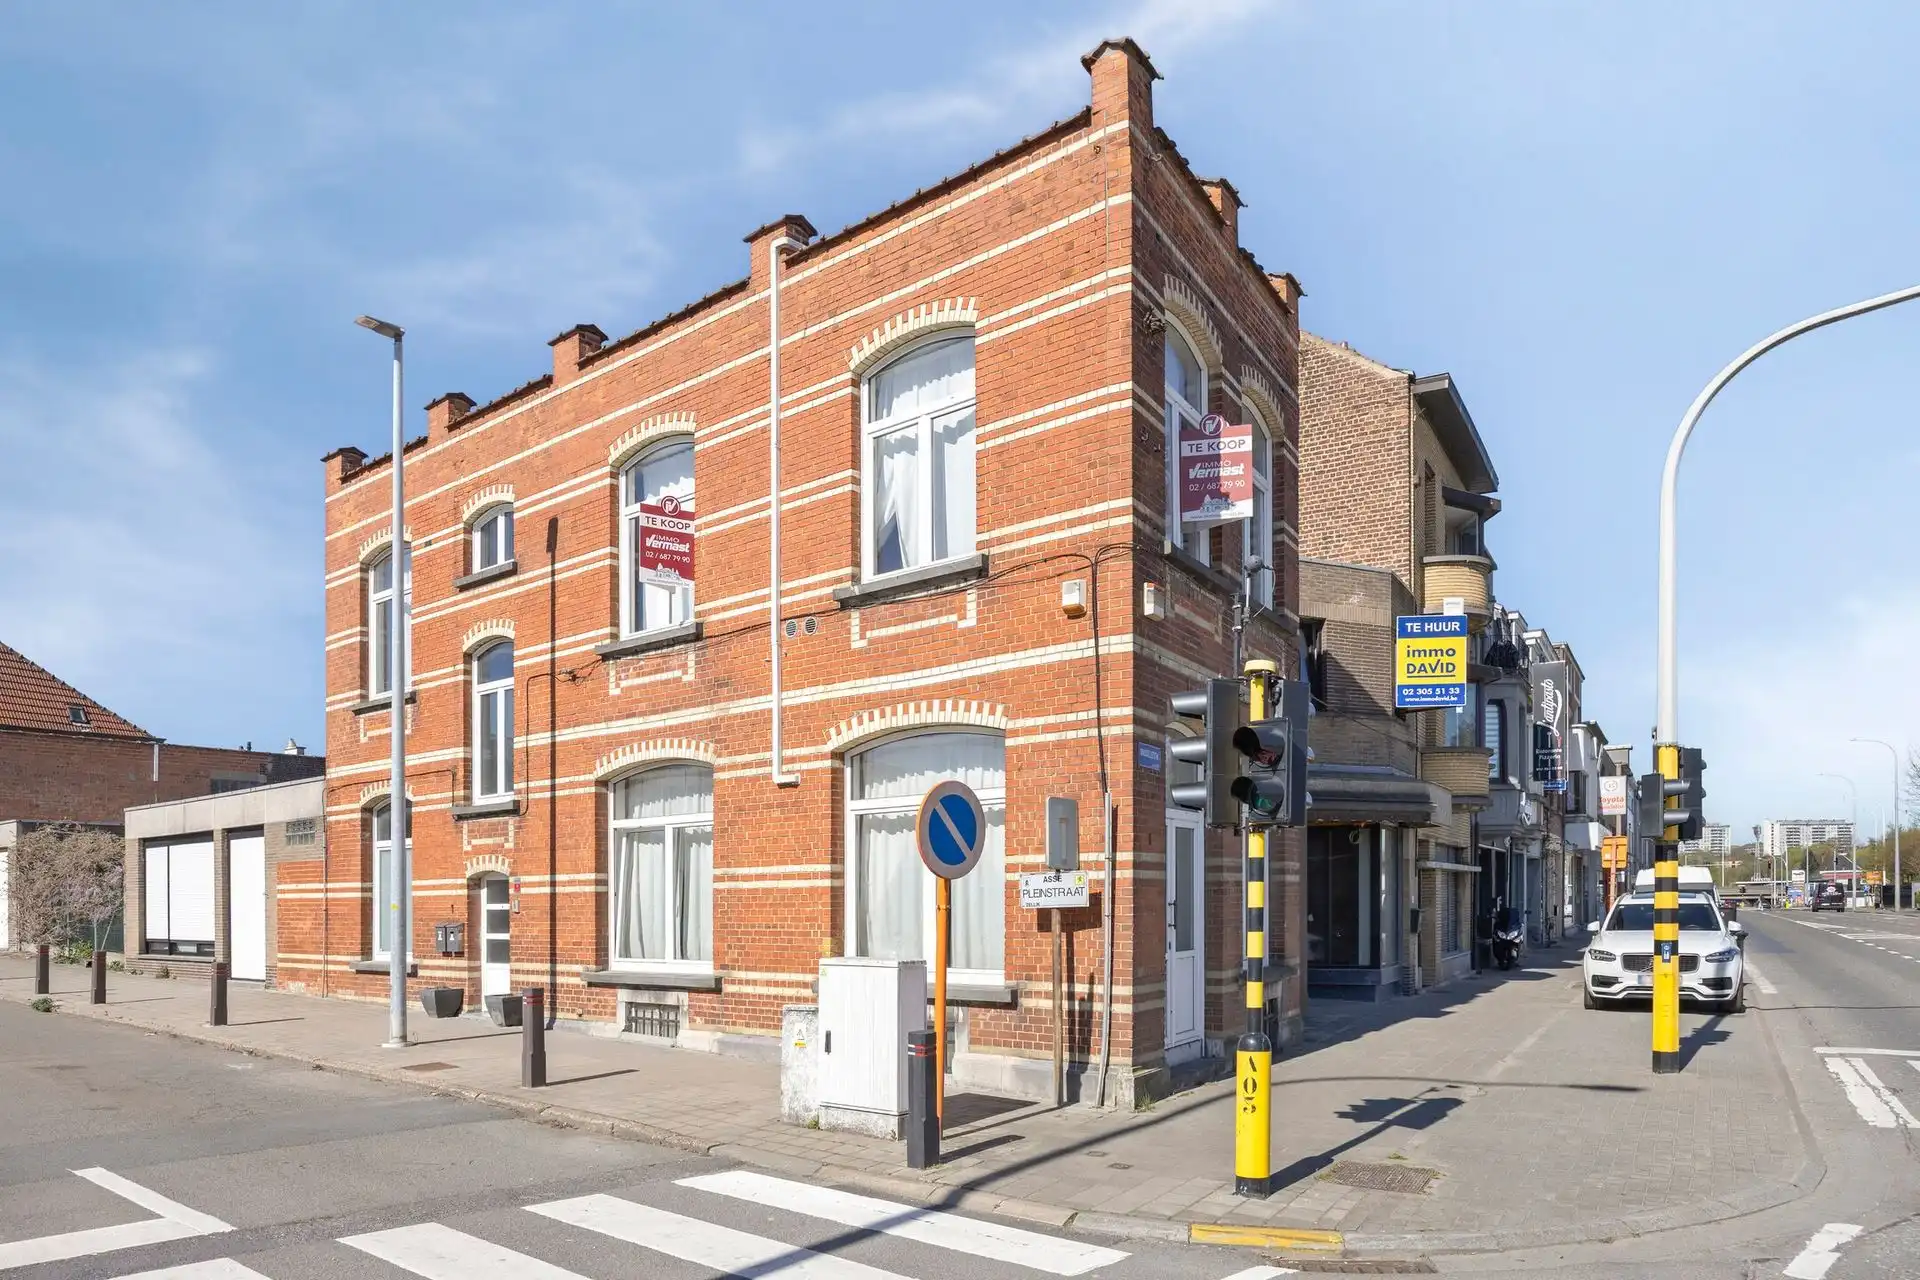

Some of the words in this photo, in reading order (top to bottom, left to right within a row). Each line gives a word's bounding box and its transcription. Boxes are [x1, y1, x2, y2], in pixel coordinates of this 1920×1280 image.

[1188, 443, 1202, 453] TE
[1208, 439, 1246, 451] KOOP
[1189, 463, 1245, 479] Vermast
[1189, 484, 1199, 492] 02
[1207, 481, 1220, 489] 687
[1236, 480, 1245, 488] 90
[645, 516, 658, 526] TE
[660, 518, 691, 531] KOOP
[646, 534, 690, 552] Vermast
[673, 554, 681, 562] 79
[1405, 623, 1421, 633] TE
[1425, 622, 1460, 632] HUUR
[1407, 645, 1456, 657] immo
[1406, 659, 1456, 674] DAVID
[1043, 875, 1062, 883] ASSE
[1023, 887, 1085, 898] PLEINSTRAAT
